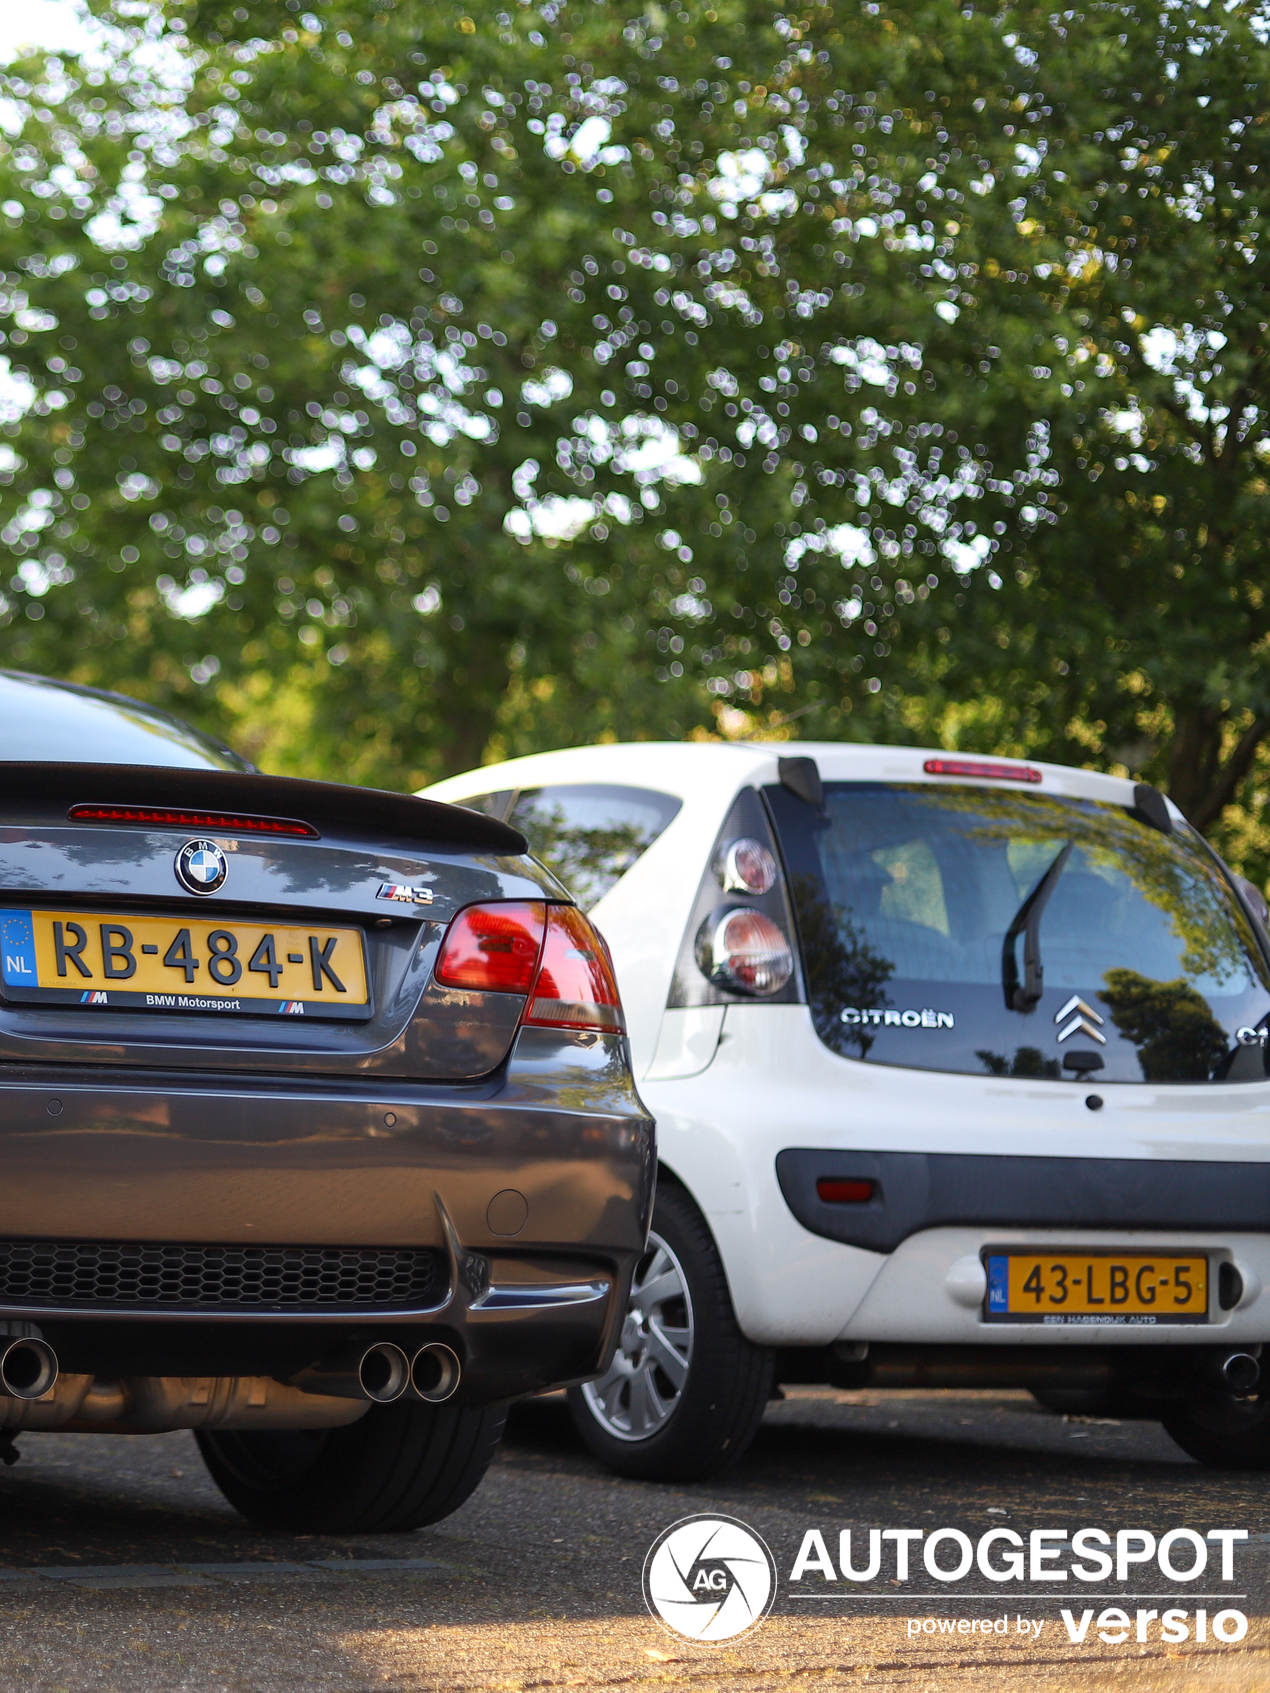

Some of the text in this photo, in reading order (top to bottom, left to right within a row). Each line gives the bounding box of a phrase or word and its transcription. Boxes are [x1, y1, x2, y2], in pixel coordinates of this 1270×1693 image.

[184, 841, 223, 859] BMW
[392, 883, 434, 905] M3
[6, 955, 32, 974] NL
[52, 920, 347, 993] RB-484-K
[146, 994, 241, 1011] BMW Motorsport
[840, 1007, 955, 1029] CITROËN
[1023, 1264, 1193, 1304] 43-LBG-5
[990, 1289, 1006, 1303] NL
[1129, 1315, 1157, 1324] AUTO
